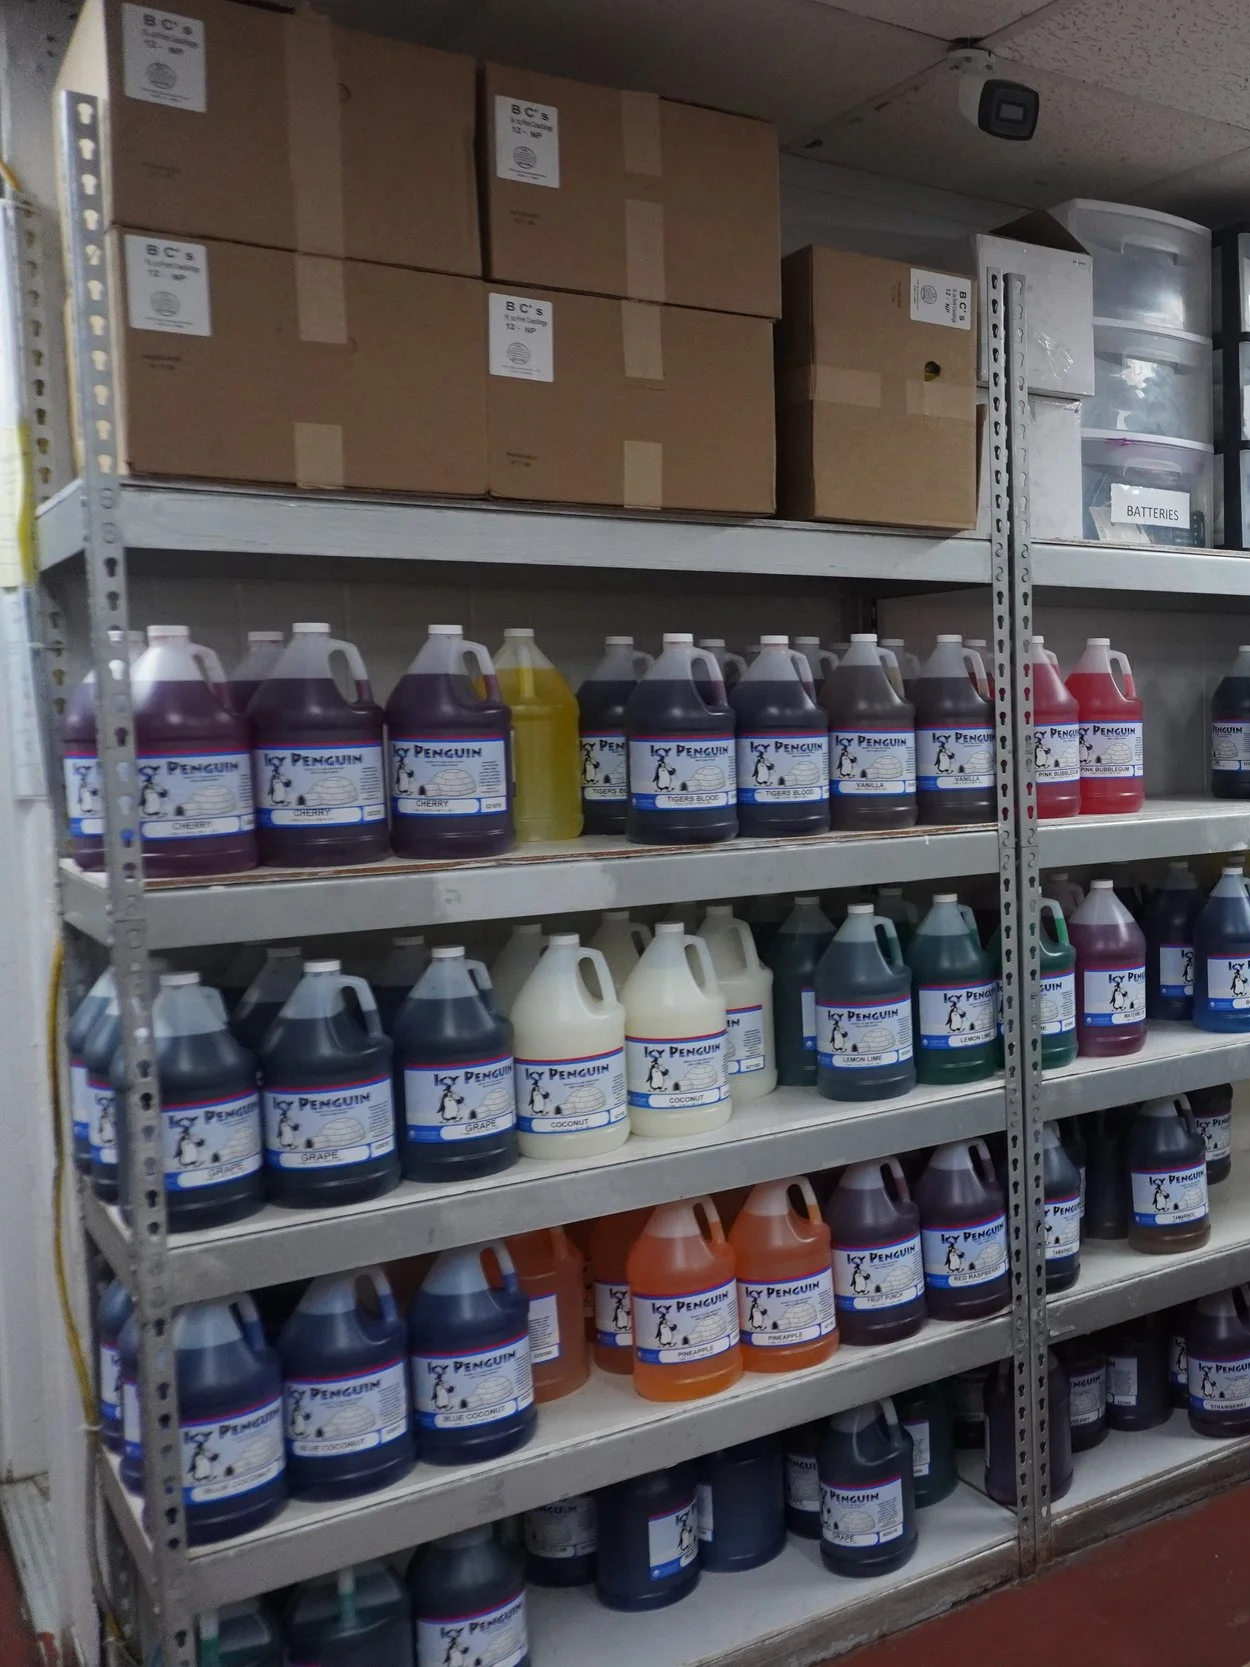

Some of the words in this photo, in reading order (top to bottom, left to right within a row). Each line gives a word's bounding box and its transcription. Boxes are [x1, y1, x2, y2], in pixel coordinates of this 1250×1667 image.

[1127, 505, 1179, 521] BATTERIES
[1093, 725, 1136, 736] PENGUIN
[836, 736, 854, 747] ICY
[858, 736, 906, 747] PENGUIN
[932, 733, 951, 743] ICY
[414, 745, 482, 758] PENGUIN
[651, 745, 671, 757] ICY
[676, 744, 728, 757] PENGUIN
[750, 741, 769, 752] ICY
[775, 741, 822, 752] PENGUIN
[265, 753, 285, 766] ICY
[291, 753, 362, 766] PENGUIN
[167, 761, 239, 776] PENGUIN
[416, 800, 448, 808] CHERRY
[293, 808, 330, 817] CHERRY
[173, 820, 210, 831] CHERRY
[1228, 961, 1244, 971] ICY
[1108, 973, 1125, 984] ICY
[944, 993, 962, 1003] ICY
[828, 1010, 843, 1021] ICY
[848, 1008, 899, 1021] PENGUIN
[960, 1035, 978, 1043] LEMON
[644, 1046, 664, 1058] ICY
[669, 1043, 720, 1058] PENGUIN
[434, 1073, 458, 1087] ICY
[465, 1065, 512, 1085] PENGUIN
[525, 1068, 544, 1080] ICY
[549, 1063, 609, 1080] PENGUIN
[273, 1097, 293, 1111] ICY
[299, 1092, 371, 1111] PENGUIN
[669, 1094, 704, 1104] COCONUT
[204, 1101, 258, 1124] PENGUIN
[465, 1120, 496, 1132] GRAPE
[551, 1118, 589, 1128] COCONUT
[301, 1151, 338, 1161] GRAPE
[208, 1162, 240, 1177] GRAPE
[1149, 1176, 1165, 1186] ICY
[1169, 1170, 1204, 1185] PENGUIN
[941, 1233, 959, 1244] ICY
[963, 1223, 1004, 1241] PENGUIN
[846, 1253, 865, 1265] ICY
[869, 1244, 916, 1263] PENGUIN
[953, 1274, 967, 1282] RED
[968, 1266, 1001, 1280] RASPBERRY
[745, 1286, 763, 1299] ICY
[767, 1280, 820, 1298] PENGUIN
[886, 1292, 904, 1300] PUNCH
[652, 1302, 672, 1314] ICY
[676, 1291, 729, 1312] PENGUIN
[768, 1332, 803, 1341] PINEAPPLE
[678, 1345, 714, 1358] PINEAPPLE
[427, 1361, 448, 1374] ICY
[453, 1350, 516, 1374] PENGUIN
[1199, 1362, 1213, 1373] ICY
[310, 1379, 381, 1401] PENGUIN
[1211, 1402, 1247, 1410] STRAWBERRY
[443, 1414, 464, 1423] BLUE
[466, 1405, 505, 1420] COCONUT
[219, 1409, 280, 1438] PENGUIN
[830, 1491, 879, 1503] PENGUIN
